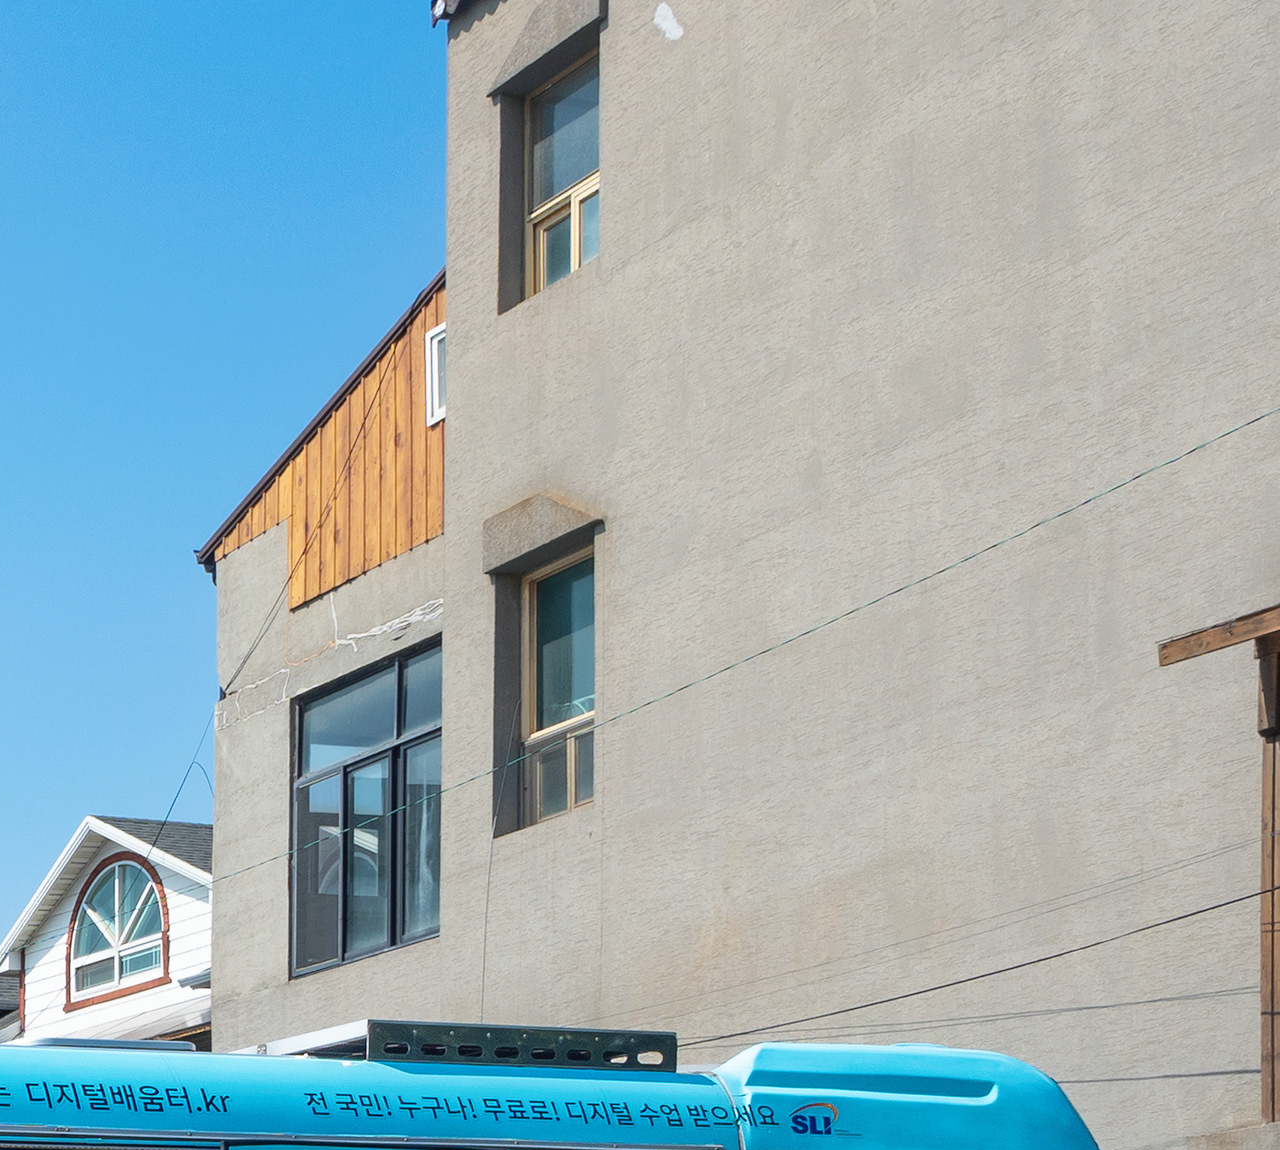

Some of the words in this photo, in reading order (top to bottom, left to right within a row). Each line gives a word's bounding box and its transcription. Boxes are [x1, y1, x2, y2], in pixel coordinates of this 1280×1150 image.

[25, 1081, 232, 1115] 디지털배움터.kr
[303, 1091, 331, 1117] 전
[335, 1093, 393, 1118] 국민!
[398, 1095, 478, 1120] 누구나!
[482, 1098, 561, 1122] 무료로!
[565, 1100, 635, 1126] 디지털
[640, 1102, 685, 1128] 수업
[689, 1104, 780, 1128] 받으세요
[790, 1114, 832, 1136] SLI
